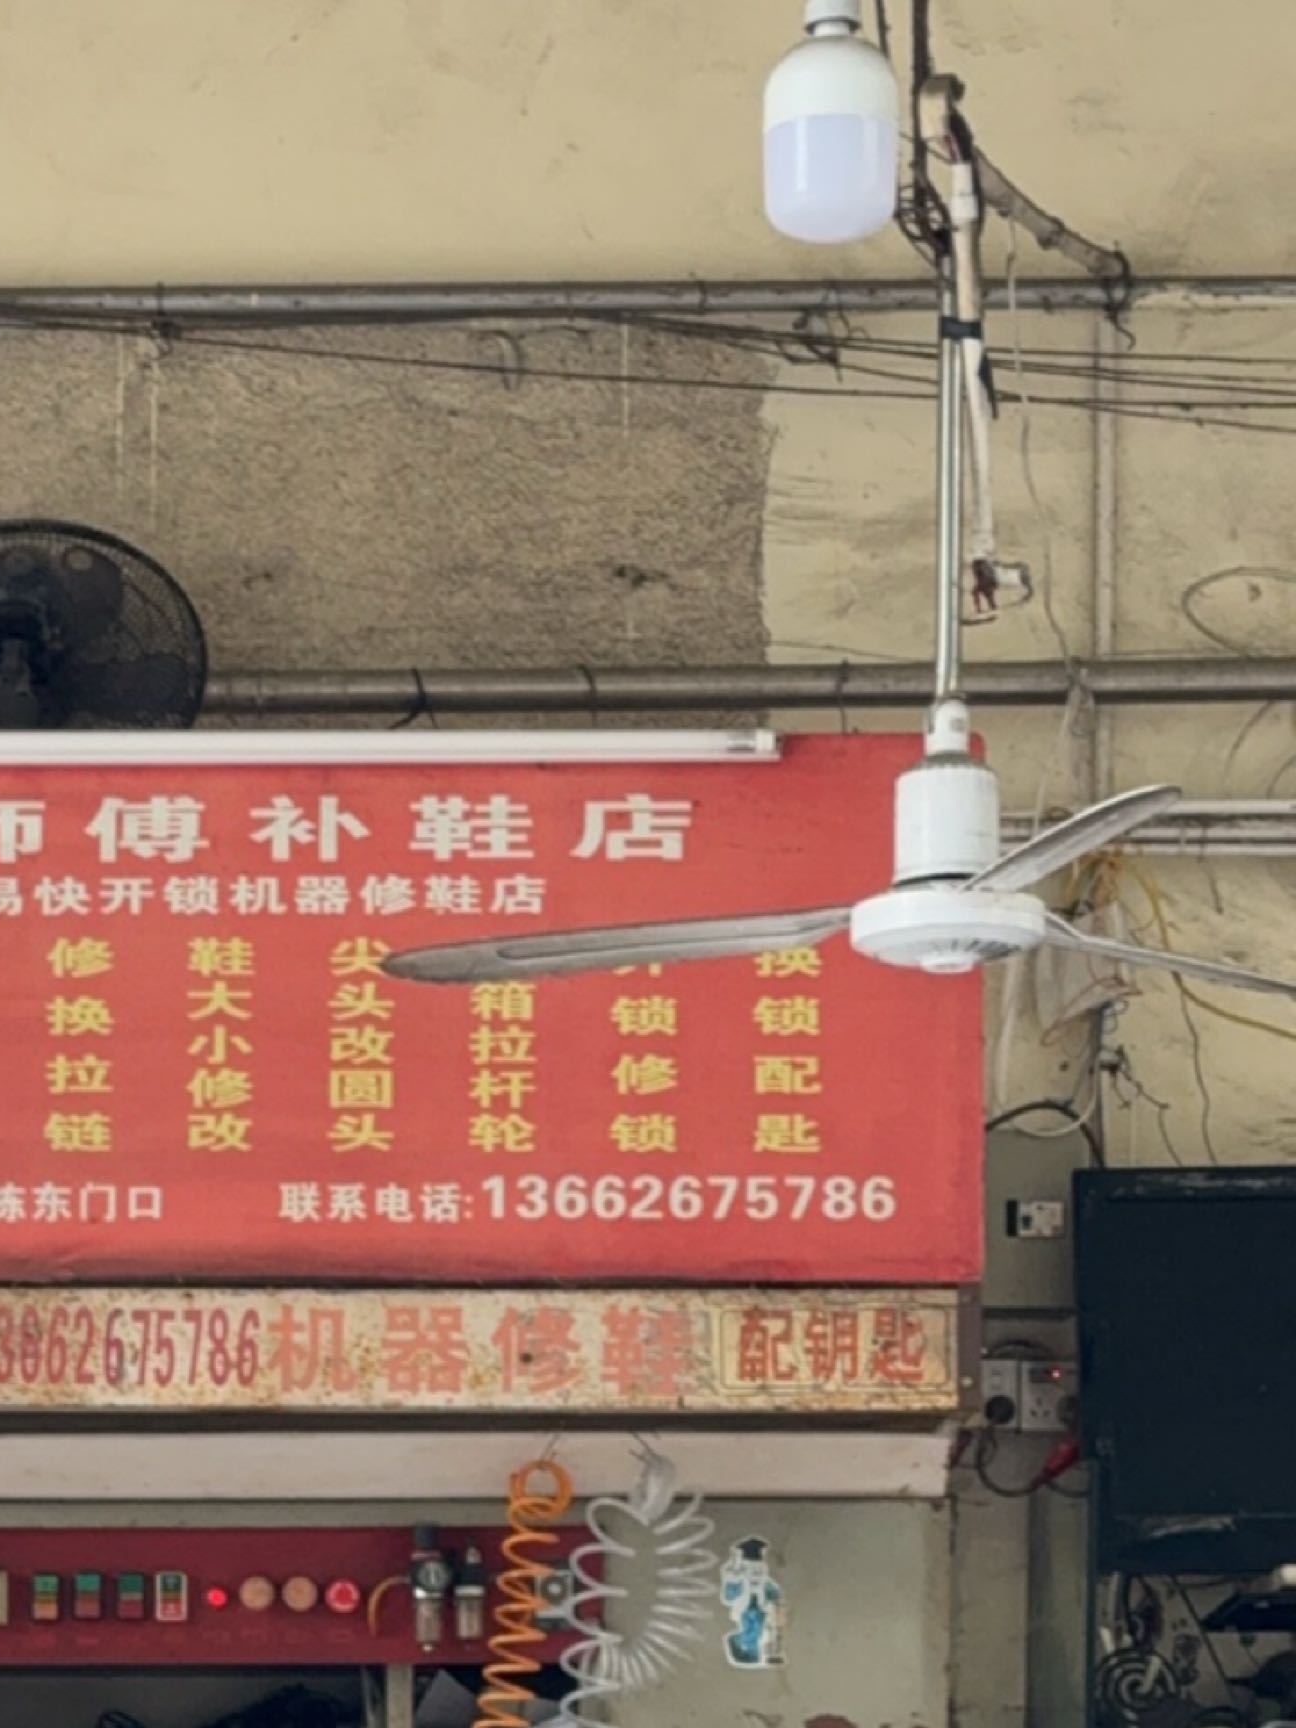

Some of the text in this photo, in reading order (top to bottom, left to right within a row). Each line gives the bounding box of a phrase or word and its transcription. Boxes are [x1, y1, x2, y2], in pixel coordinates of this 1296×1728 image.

[44, 938, 115, 1153] 修换拉链
[186, 937, 254, 1152] 鞋大小修改
[328, 937, 396, 1152] 尖头改圆头
[267, 1304, 693, 1396] 机器修鞋
[737, 1307, 925, 1384] 配钥匙
